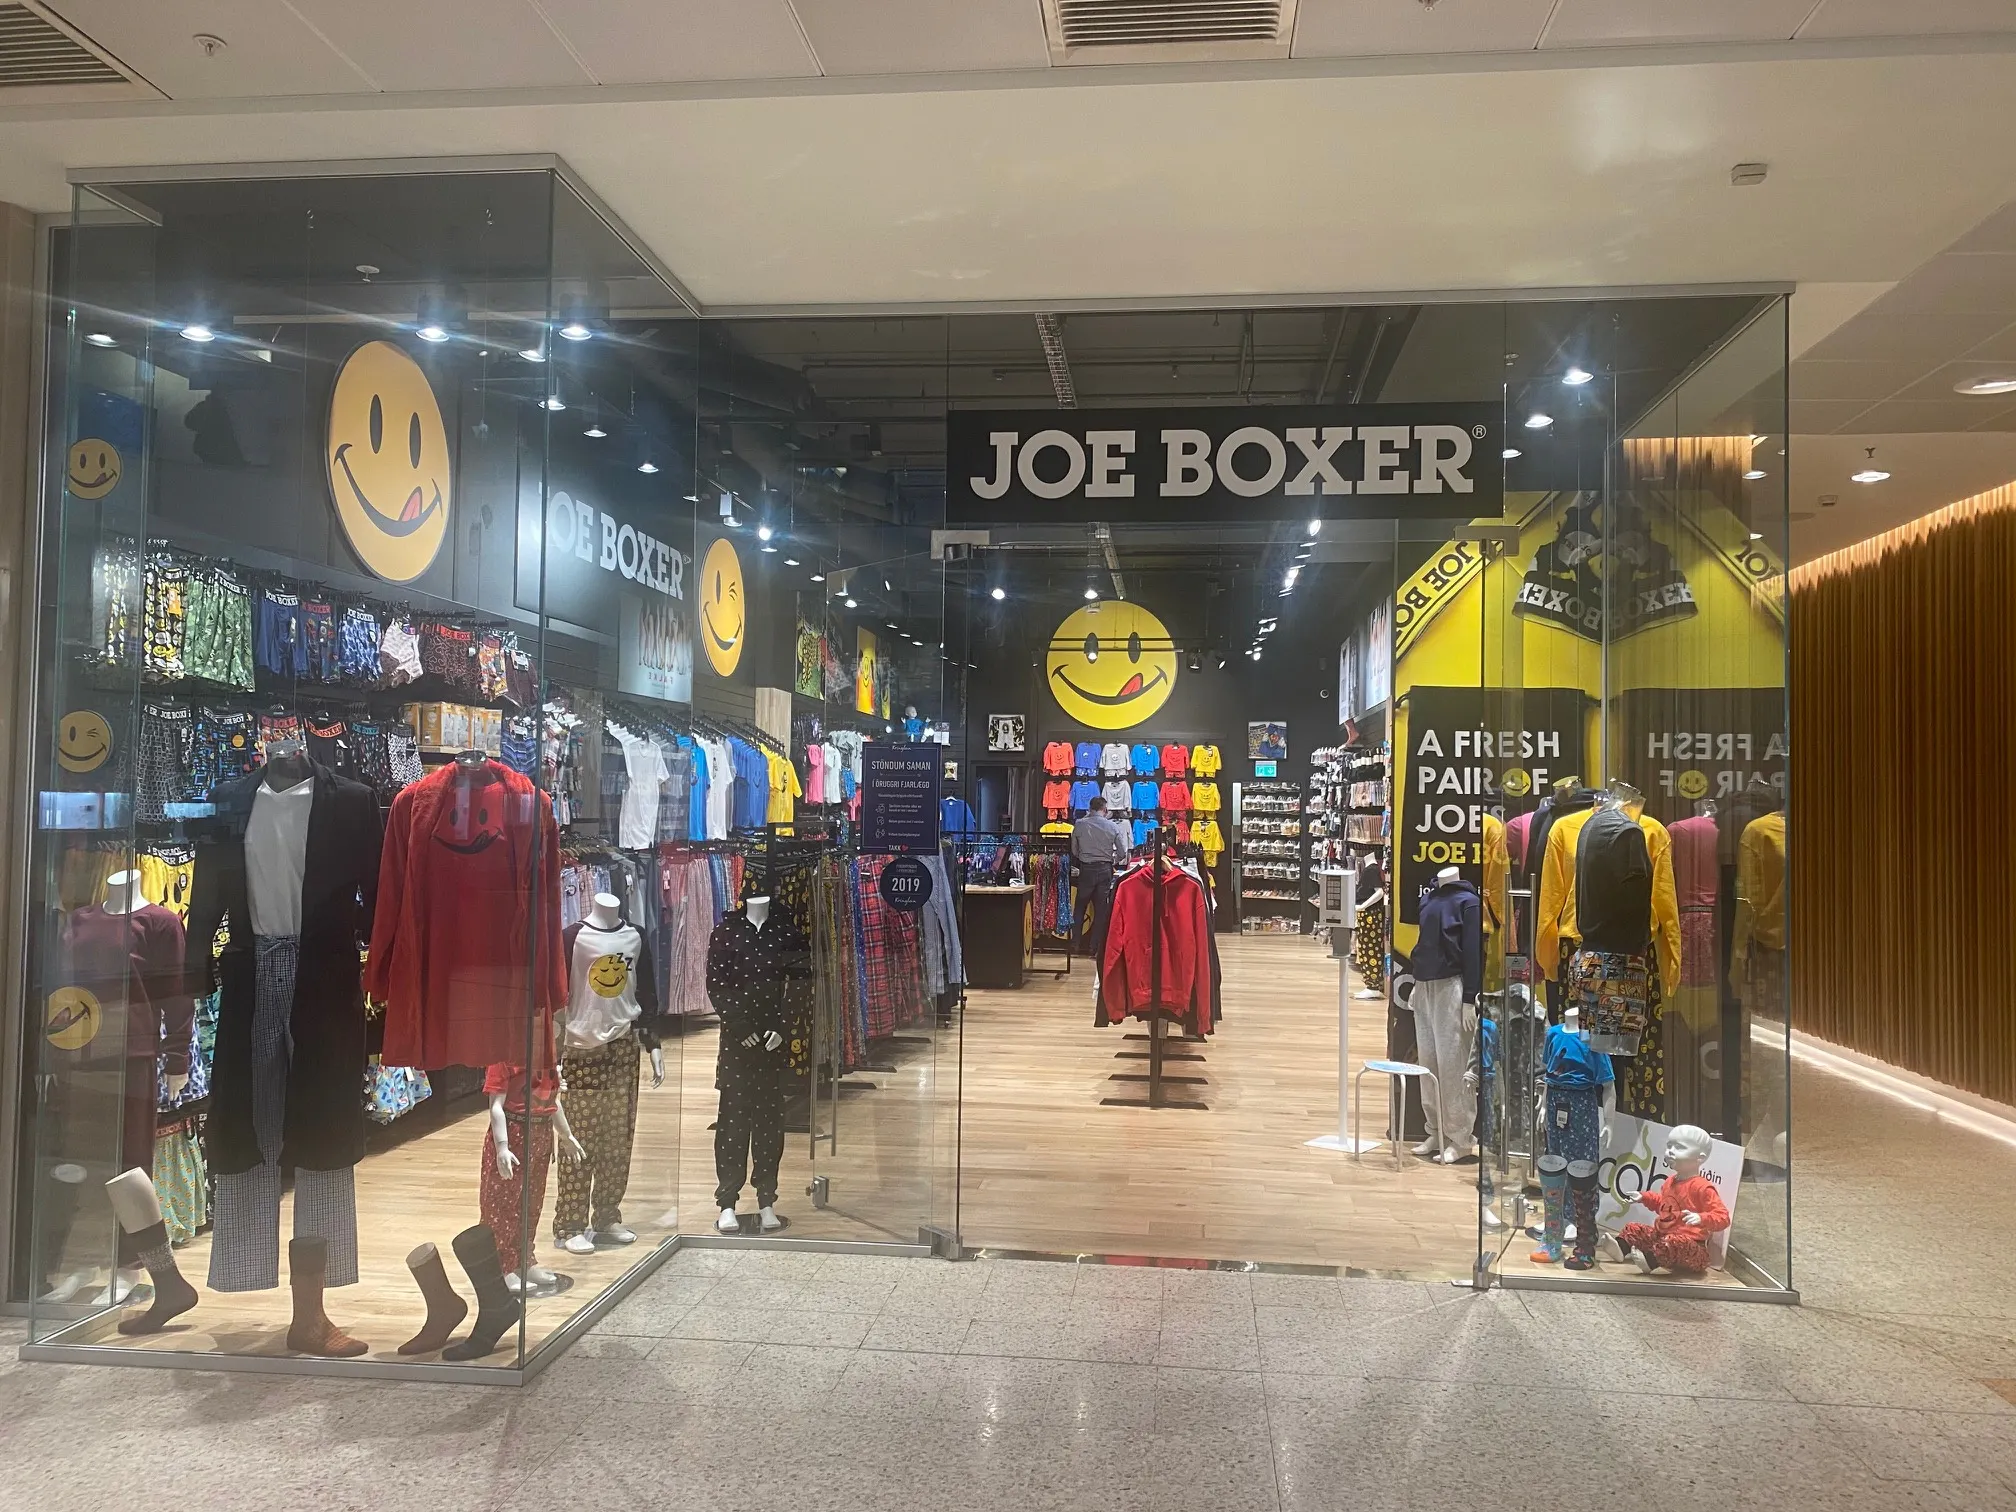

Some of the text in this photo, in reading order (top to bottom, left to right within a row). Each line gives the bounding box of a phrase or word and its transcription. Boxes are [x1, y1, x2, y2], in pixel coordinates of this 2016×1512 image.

[969, 430, 1136, 499] JOE
[600, 511, 684, 600] BOXER
[1396, 541, 1475, 634] JOE BO
[1417, 729, 1560, 759] A FRESH
[871, 760, 931, 770] STÖNDUM SAMAN
[1418, 766, 1495, 795] PAIR
[1413, 841, 1466, 864] JOE
[891, 878, 920, 892] 2019
